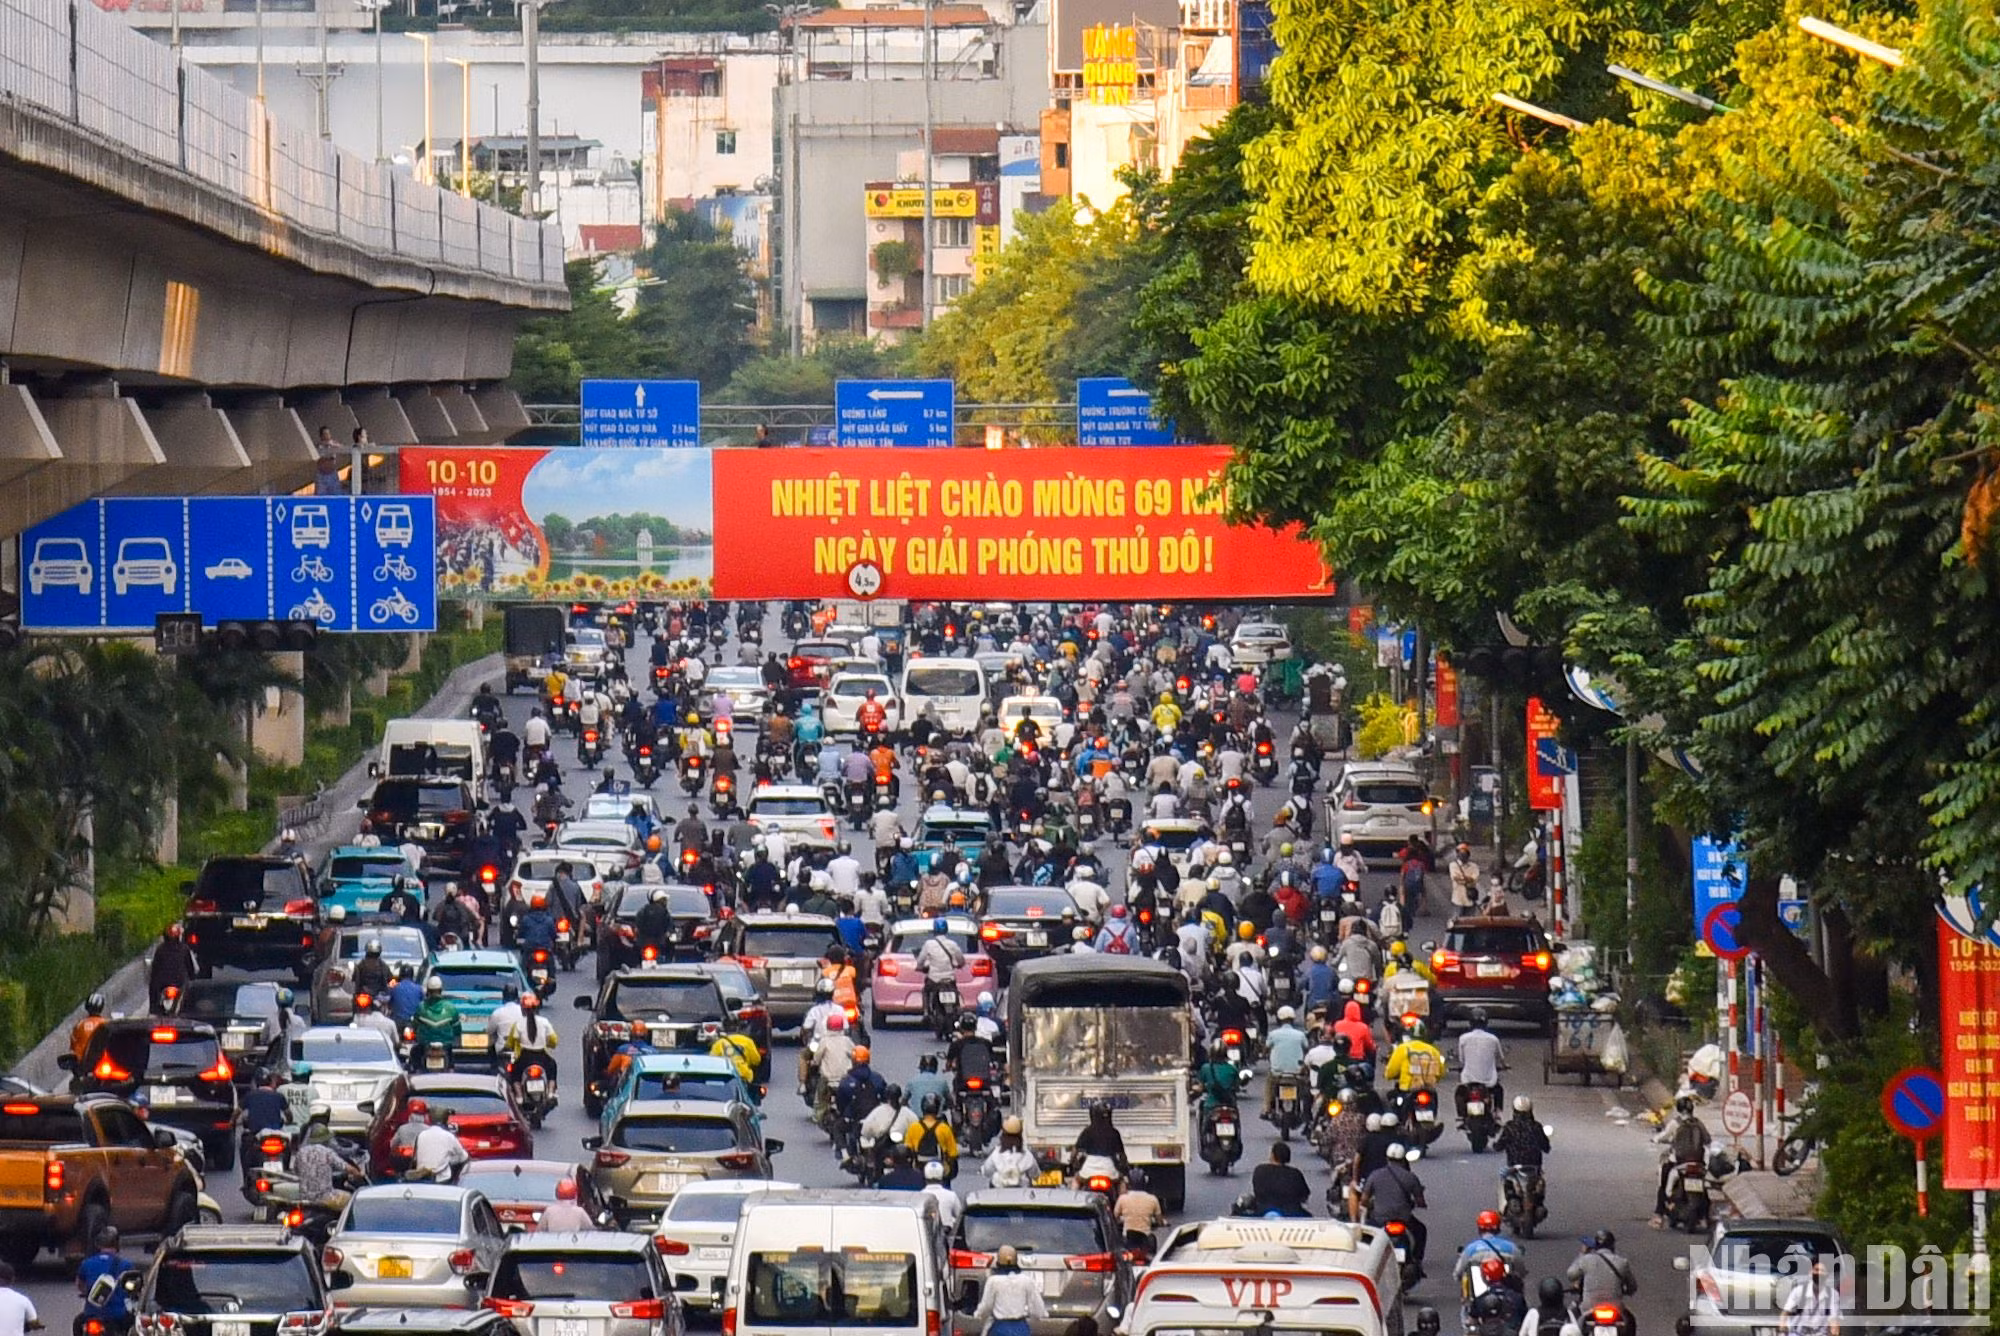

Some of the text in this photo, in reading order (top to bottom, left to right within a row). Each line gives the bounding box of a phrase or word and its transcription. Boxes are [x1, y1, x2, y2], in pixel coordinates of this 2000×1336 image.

[771, 469, 1234, 525] NHIỆT LIỆT CHÀO MỪNG 69 NĂ
[814, 529, 897, 575] NGÀY
[906, 524, 968, 575] GIẢI
[978, 529, 1083, 576] PHÓNG
[1092, 524, 1150, 575] THỦ
[1221, 1277, 1292, 1308] VIP
